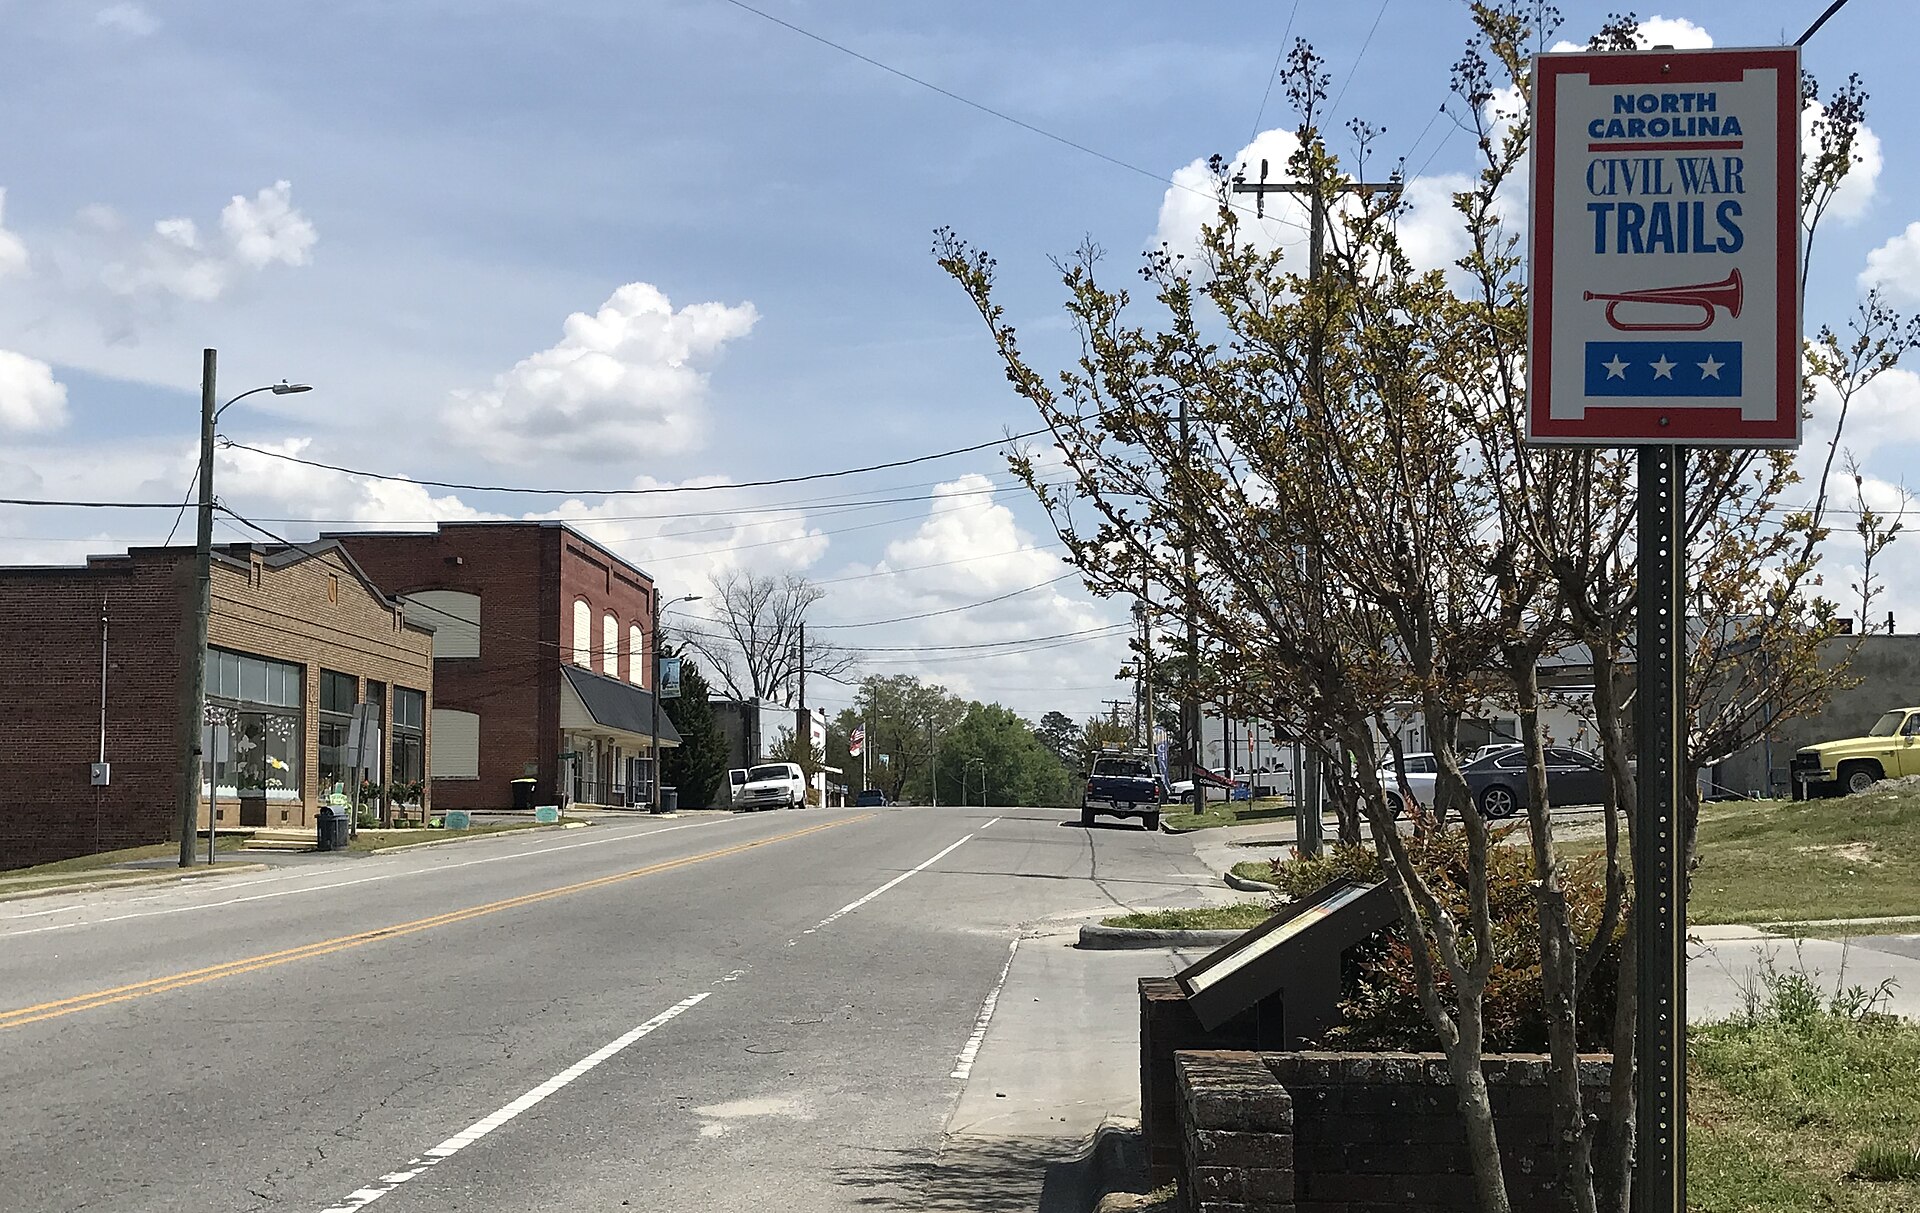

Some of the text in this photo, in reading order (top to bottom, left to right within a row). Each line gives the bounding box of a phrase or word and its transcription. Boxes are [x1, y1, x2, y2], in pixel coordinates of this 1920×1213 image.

[1613, 93, 1716, 114] NORTH
[1588, 116, 1743, 138] CAROLINA
[1586, 157, 1745, 195] CIVIL WAR
[1587, 200, 1744, 254] TRAILS
